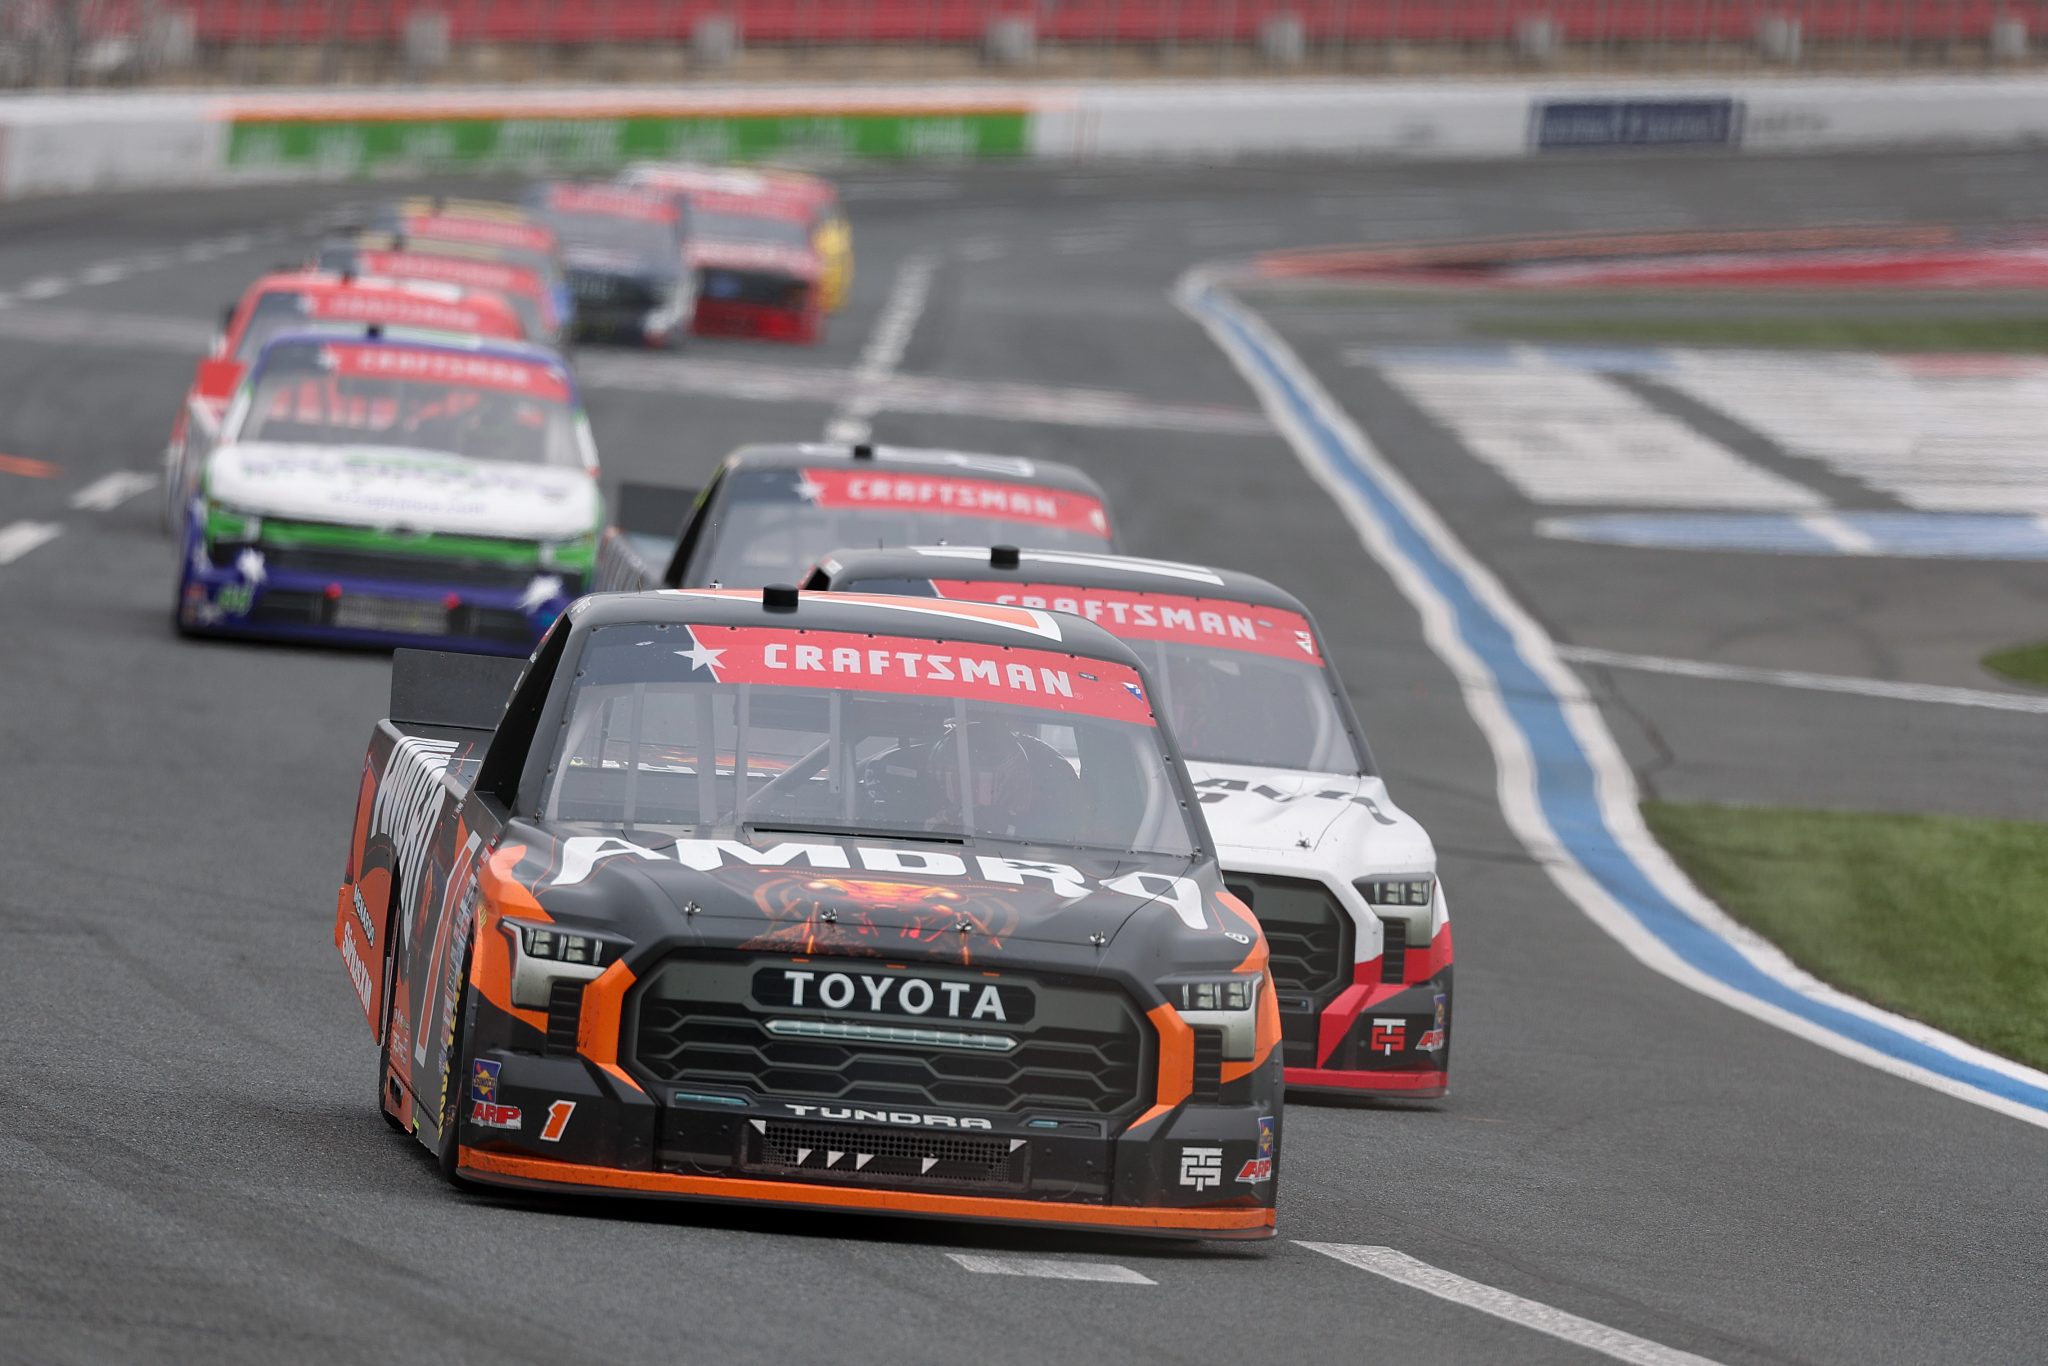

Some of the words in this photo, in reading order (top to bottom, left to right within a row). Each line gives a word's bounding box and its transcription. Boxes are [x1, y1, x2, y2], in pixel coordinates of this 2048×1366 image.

[849, 479, 1058, 518] CRAFTSMAN
[763, 643, 1074, 698] CRAFTSMAN
[784, 971, 1007, 1022] TOYOTA
[540, 1100, 577, 1142] 1
[784, 1103, 993, 1130] TUNDRA
